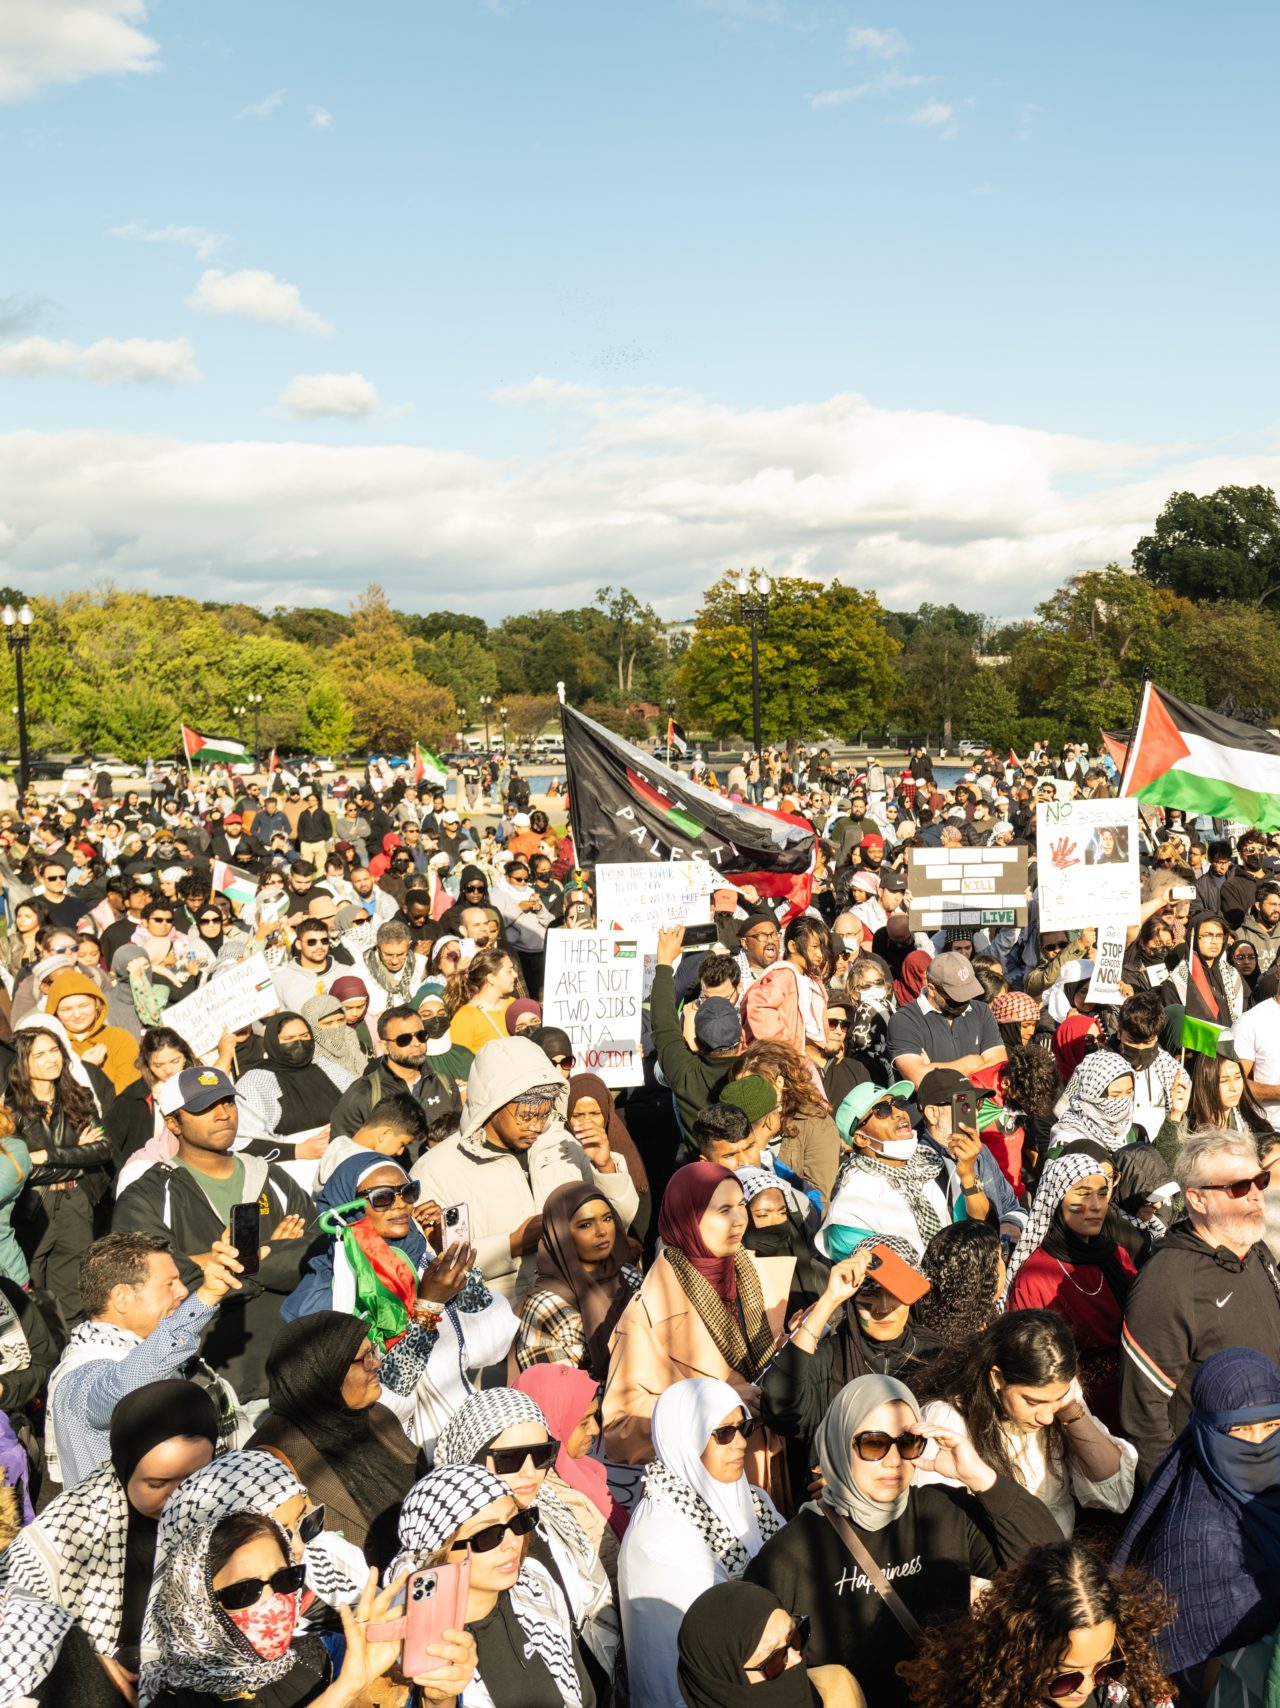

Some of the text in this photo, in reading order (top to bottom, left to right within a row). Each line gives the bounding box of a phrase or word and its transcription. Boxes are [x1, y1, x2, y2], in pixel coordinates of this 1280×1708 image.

[1046, 802, 1073, 823] NO
[629, 866, 647, 880] THE
[963, 880, 994, 891] KILL
[982, 911, 1014, 924] LIVE
[560, 938, 608, 964] THERE
[1101, 942, 1123, 959] STOP
[1100, 958, 1121, 968] GENOCIDE
[555, 970, 589, 996] ARE
[597, 968, 633, 993] NOT
[1096, 968, 1120, 985] NOW
[553, 996, 637, 1022] TWO SIDES
[564, 1024, 615, 1045] IN A
[575, 1049, 634, 1071] NOCIDE!
